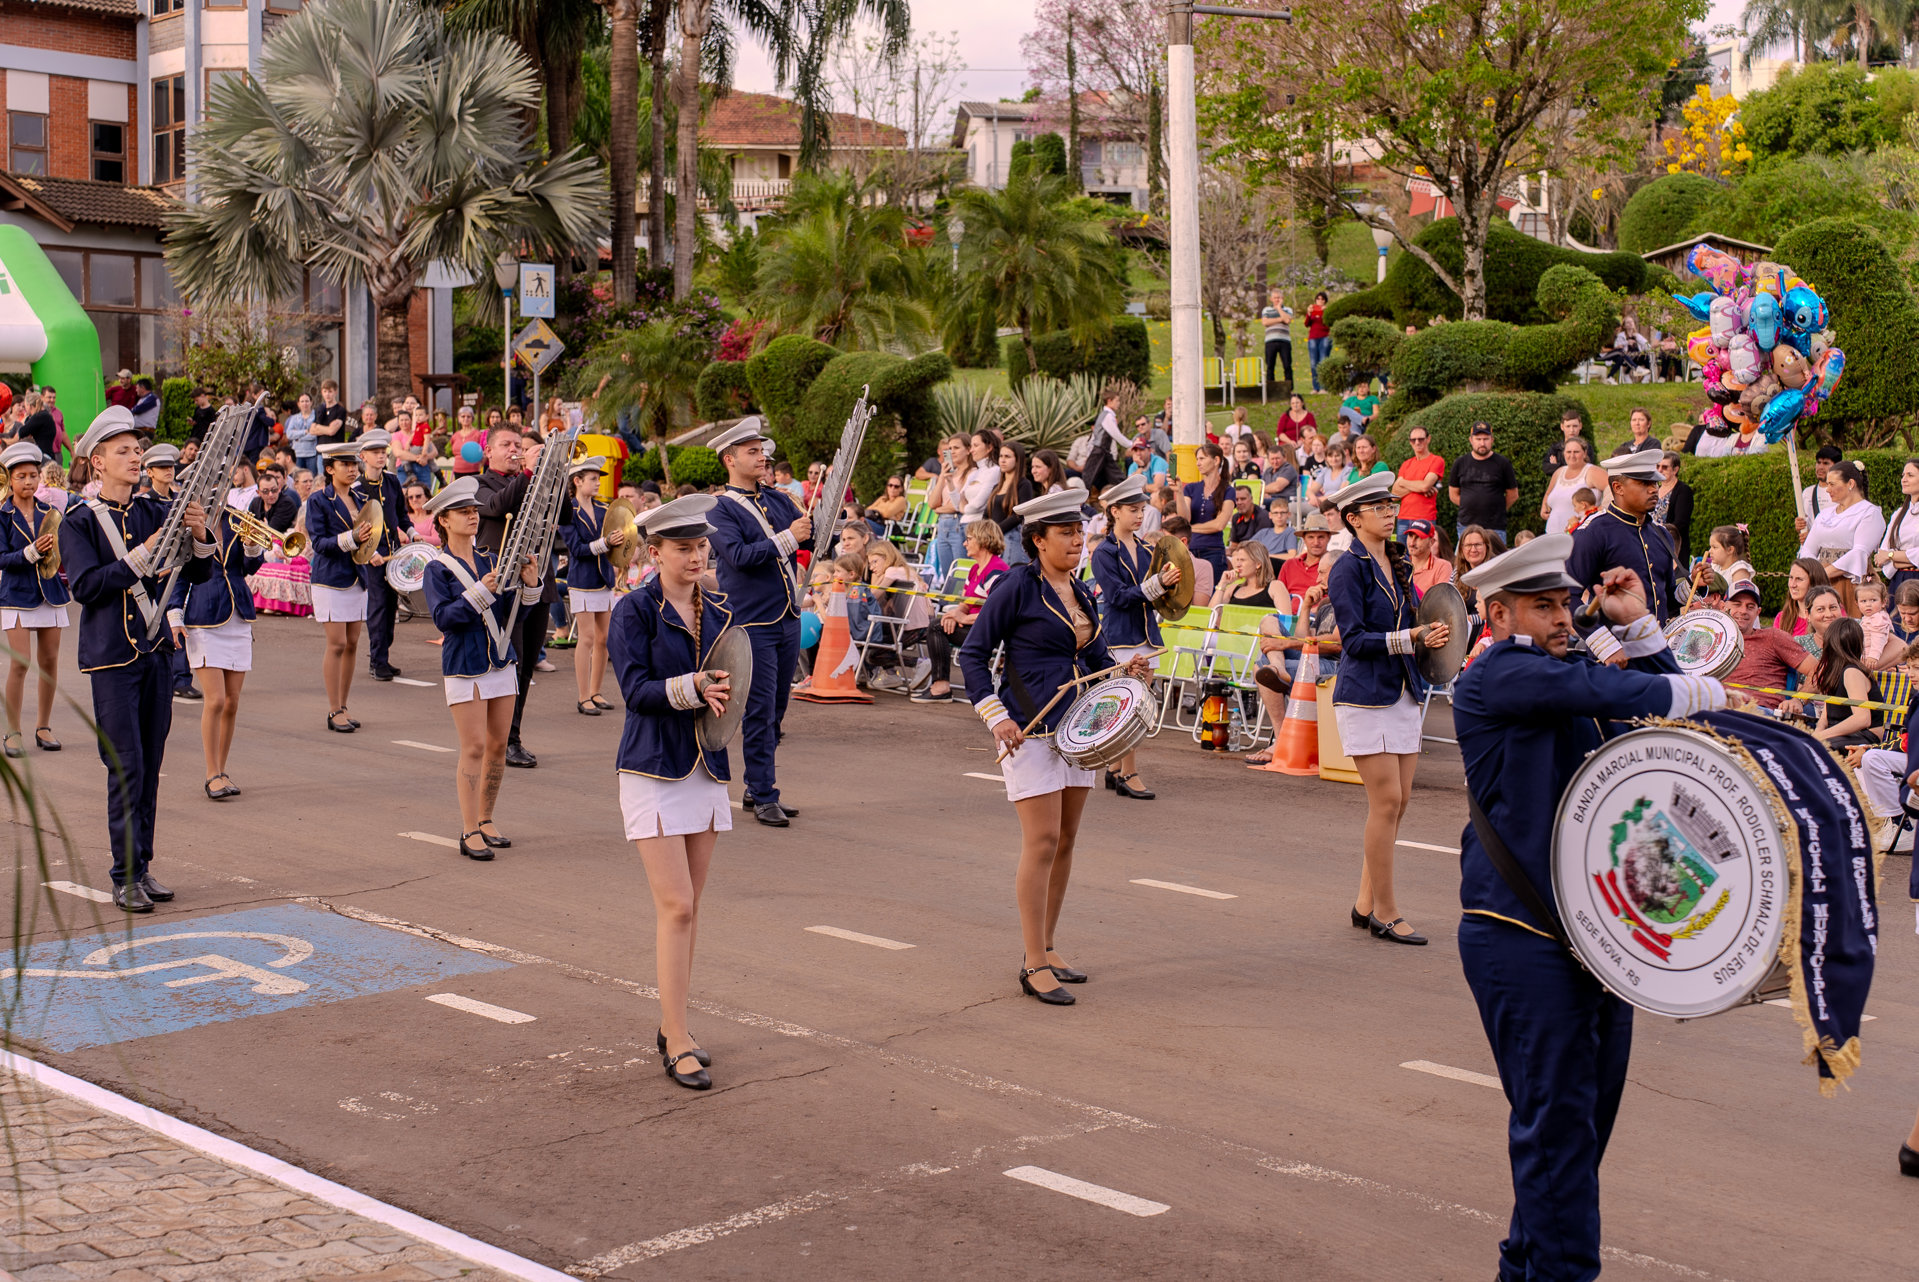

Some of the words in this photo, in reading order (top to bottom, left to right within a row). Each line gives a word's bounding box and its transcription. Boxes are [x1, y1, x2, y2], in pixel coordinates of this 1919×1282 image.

[1596, 749, 1643, 785] MARCIAL
[1645, 746, 1705, 772] MUNICIPAL
[1707, 764, 1739, 799] PROF.
[1756, 748, 1800, 800] BANDA
[1573, 781, 1601, 823] BANDA
[1736, 796, 1772, 866] RODICLER
[1795, 807, 1826, 893] MARCIAL
[1752, 870, 1774, 937] SCHMALZ
[1576, 910, 1600, 939] SEDE
[1597, 936, 1622, 968] NOVA
[1625, 969, 1640, 986] RS
[1713, 952, 1746, 984] JESUS
[1742, 936, 1760, 956] DE
[1809, 903, 1829, 1021] MUNICIPAL
